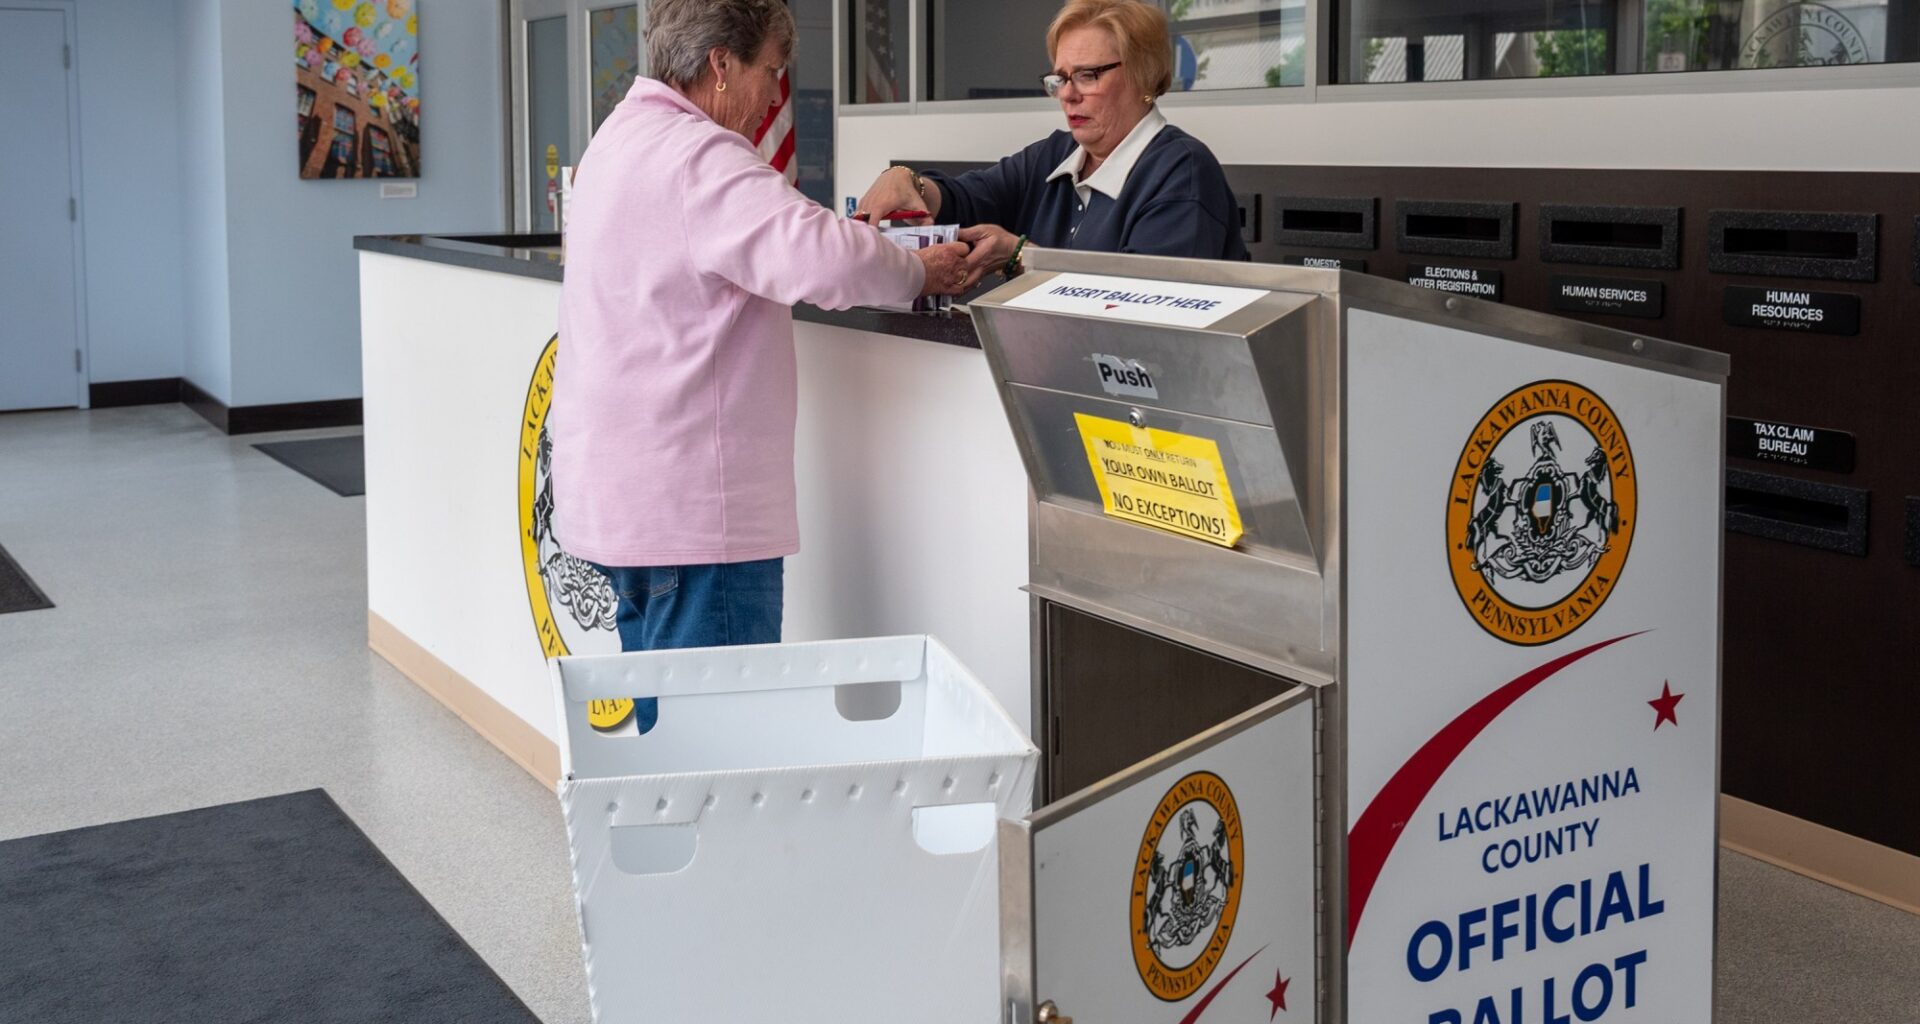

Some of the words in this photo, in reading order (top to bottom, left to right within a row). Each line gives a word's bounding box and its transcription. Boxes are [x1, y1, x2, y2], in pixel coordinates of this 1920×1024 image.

[1304, 257, 1341, 269] DOMESTIC
[1425, 266, 1470, 280] ELECTIONS
[1472, 270, 1478, 281] &
[1049, 285, 1109, 299] INSERT
[1105, 290, 1171, 306] BALLOT
[1172, 297, 1221, 311] HERE
[1409, 277, 1435, 290] VOTER
[1436, 280, 1496, 295] REGISTRATION
[1562, 285, 1597, 298] HUMAN
[1599, 288, 1647, 302] SERVICES
[1766, 290, 1810, 305] HUMAN
[1752, 304, 1823, 321] RESOURCES
[1099, 363, 1152, 388] Push
[1754, 422, 1776, 437] TAX
[1777, 426, 1814, 442] CLAIM
[1144, 448, 1166, 461] ONLY
[1166, 454, 1197, 468] RETURN
[1455, 389, 1570, 505] LACKAWANNA
[1576, 397, 1629, 480] COUNTY
[1759, 438, 1807, 456] BUREAU
[1102, 457, 1137, 476] YOUR
[1137, 466, 1168, 485] OWN
[1169, 473, 1214, 496] BALLOT
[1113, 491, 1133, 511] NO
[1137, 498, 1227, 537] EXCEPTIONS!
[1471, 574, 1610, 637] PENNSYLVANIA
[1439, 767, 1640, 841] LACKAWANNA
[1135, 779, 1203, 897] LACKAWANNA
[1206, 780, 1240, 840] COUNTY
[1482, 818, 1599, 874] COUNTY
[1406, 863, 1664, 983] OFFICIAL
[1147, 923, 1229, 994] PENNSYLVANIA
[1428, 949, 1647, 1024] LLOT
